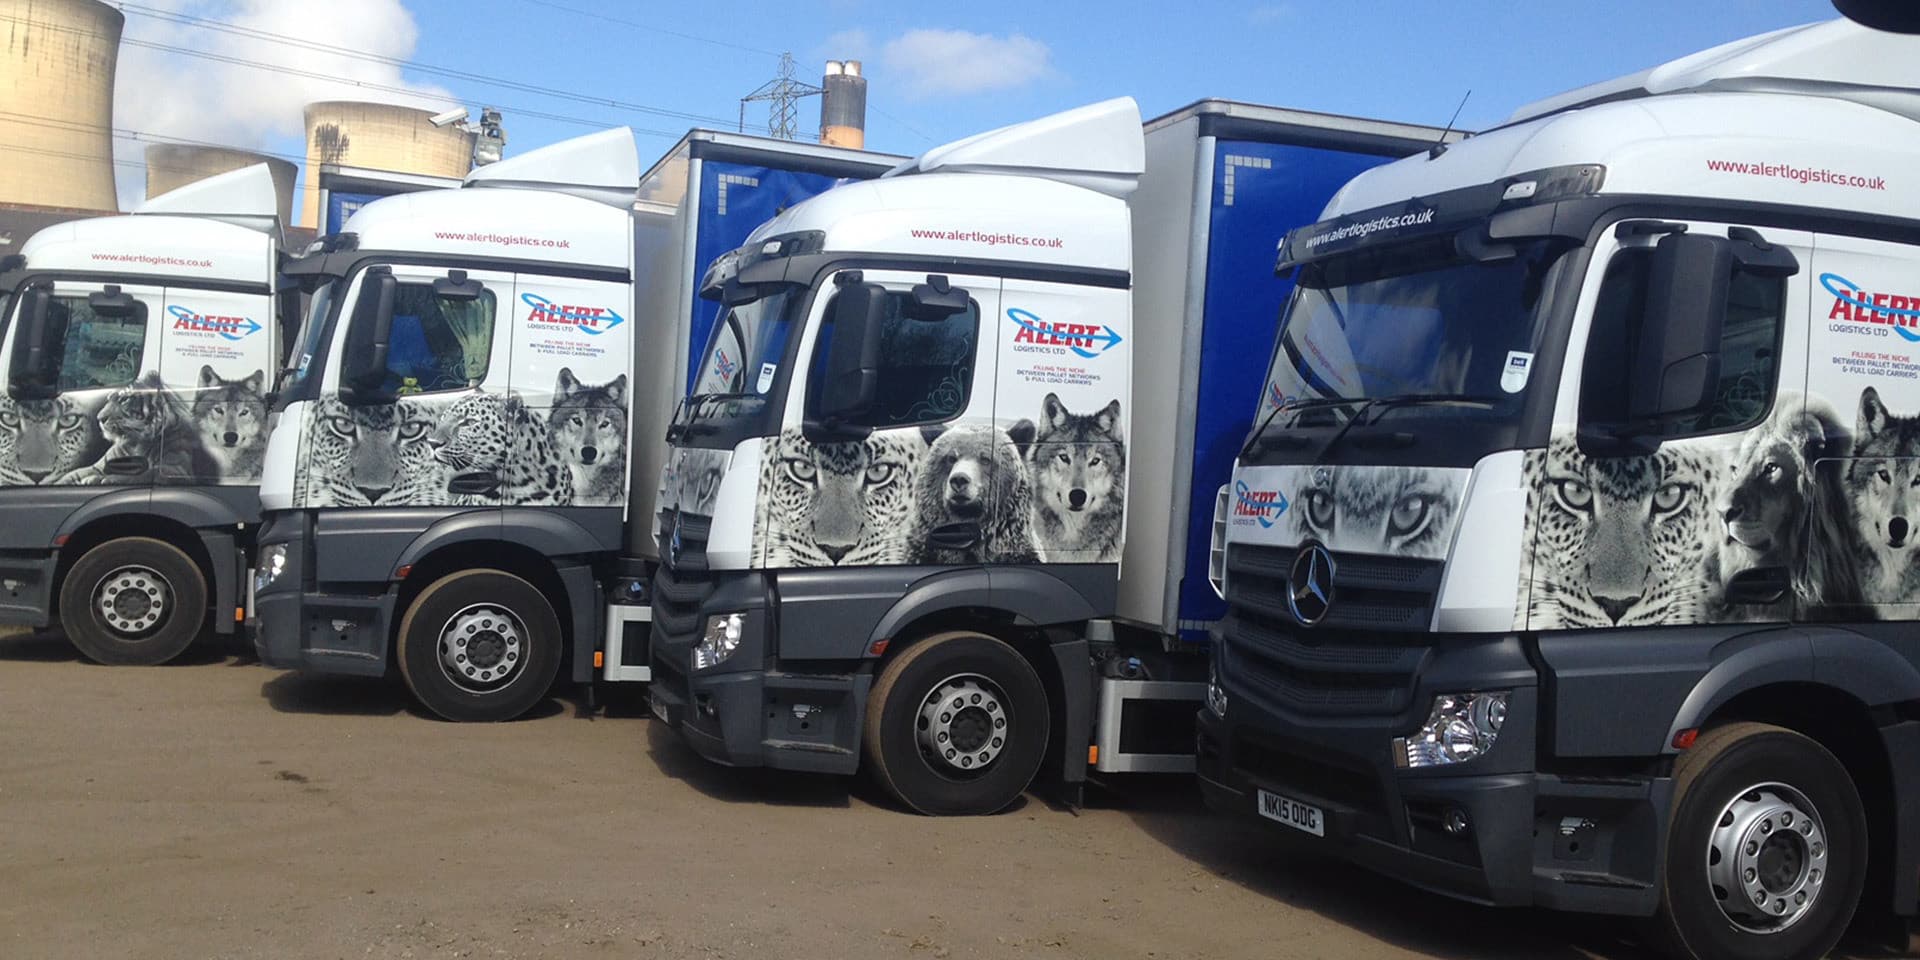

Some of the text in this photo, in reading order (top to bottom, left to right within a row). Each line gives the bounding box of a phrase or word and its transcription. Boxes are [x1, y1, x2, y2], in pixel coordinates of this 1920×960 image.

[1706, 159, 1886, 190] www.alertlogistics.co.uk
[1305, 208, 1434, 248] www.alertlogistics.co.uk
[435, 232, 570, 248] www.alertlogistics.co.uk
[911, 229, 1063, 248] www.alertlogistics.co.uk
[528, 303, 605, 326] ALERT
[1829, 289, 1920, 327] ALERT
[173, 313, 244, 333] ALERT
[527, 323, 560, 332] LOGISTICS
[1829, 324, 1888, 337] LOGISTICS LTD
[1014, 320, 1101, 348] ALERT
[1014, 345, 1051, 355] LOGISTICS
[1851, 351, 1876, 360] FILLING
[1878, 353, 1890, 361] THE
[1832, 357, 1865, 367] BETWEEN
[1867, 360, 1890, 369] PALLET
[1850, 367, 1866, 375] FULL
[1867, 368, 1885, 377] LOAD
[1234, 491, 1277, 516] ALERT
[1264, 793, 1315, 829] NK15 ODG
